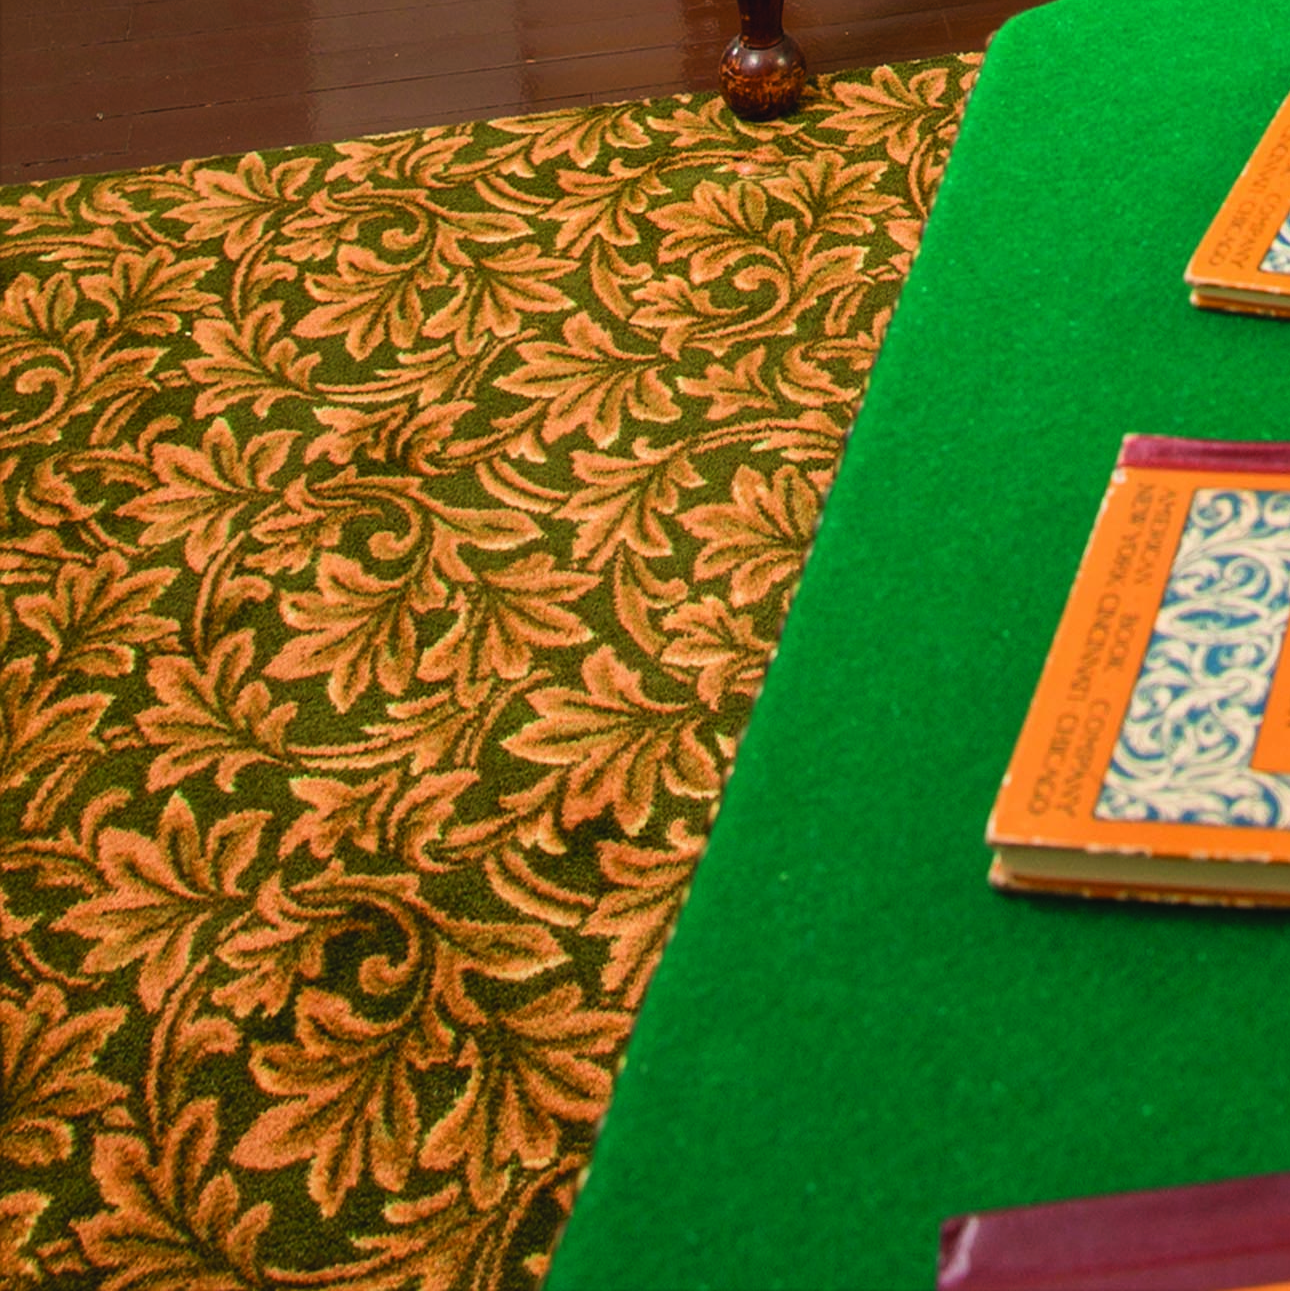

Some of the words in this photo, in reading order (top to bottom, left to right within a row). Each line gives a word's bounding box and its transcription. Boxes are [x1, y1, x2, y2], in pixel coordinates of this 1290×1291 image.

[1104, 613, 1140, 672] BOOK
[1027, 713, 1080, 816] CHICAGO
[1054, 698, 1112, 817] COMPANY
